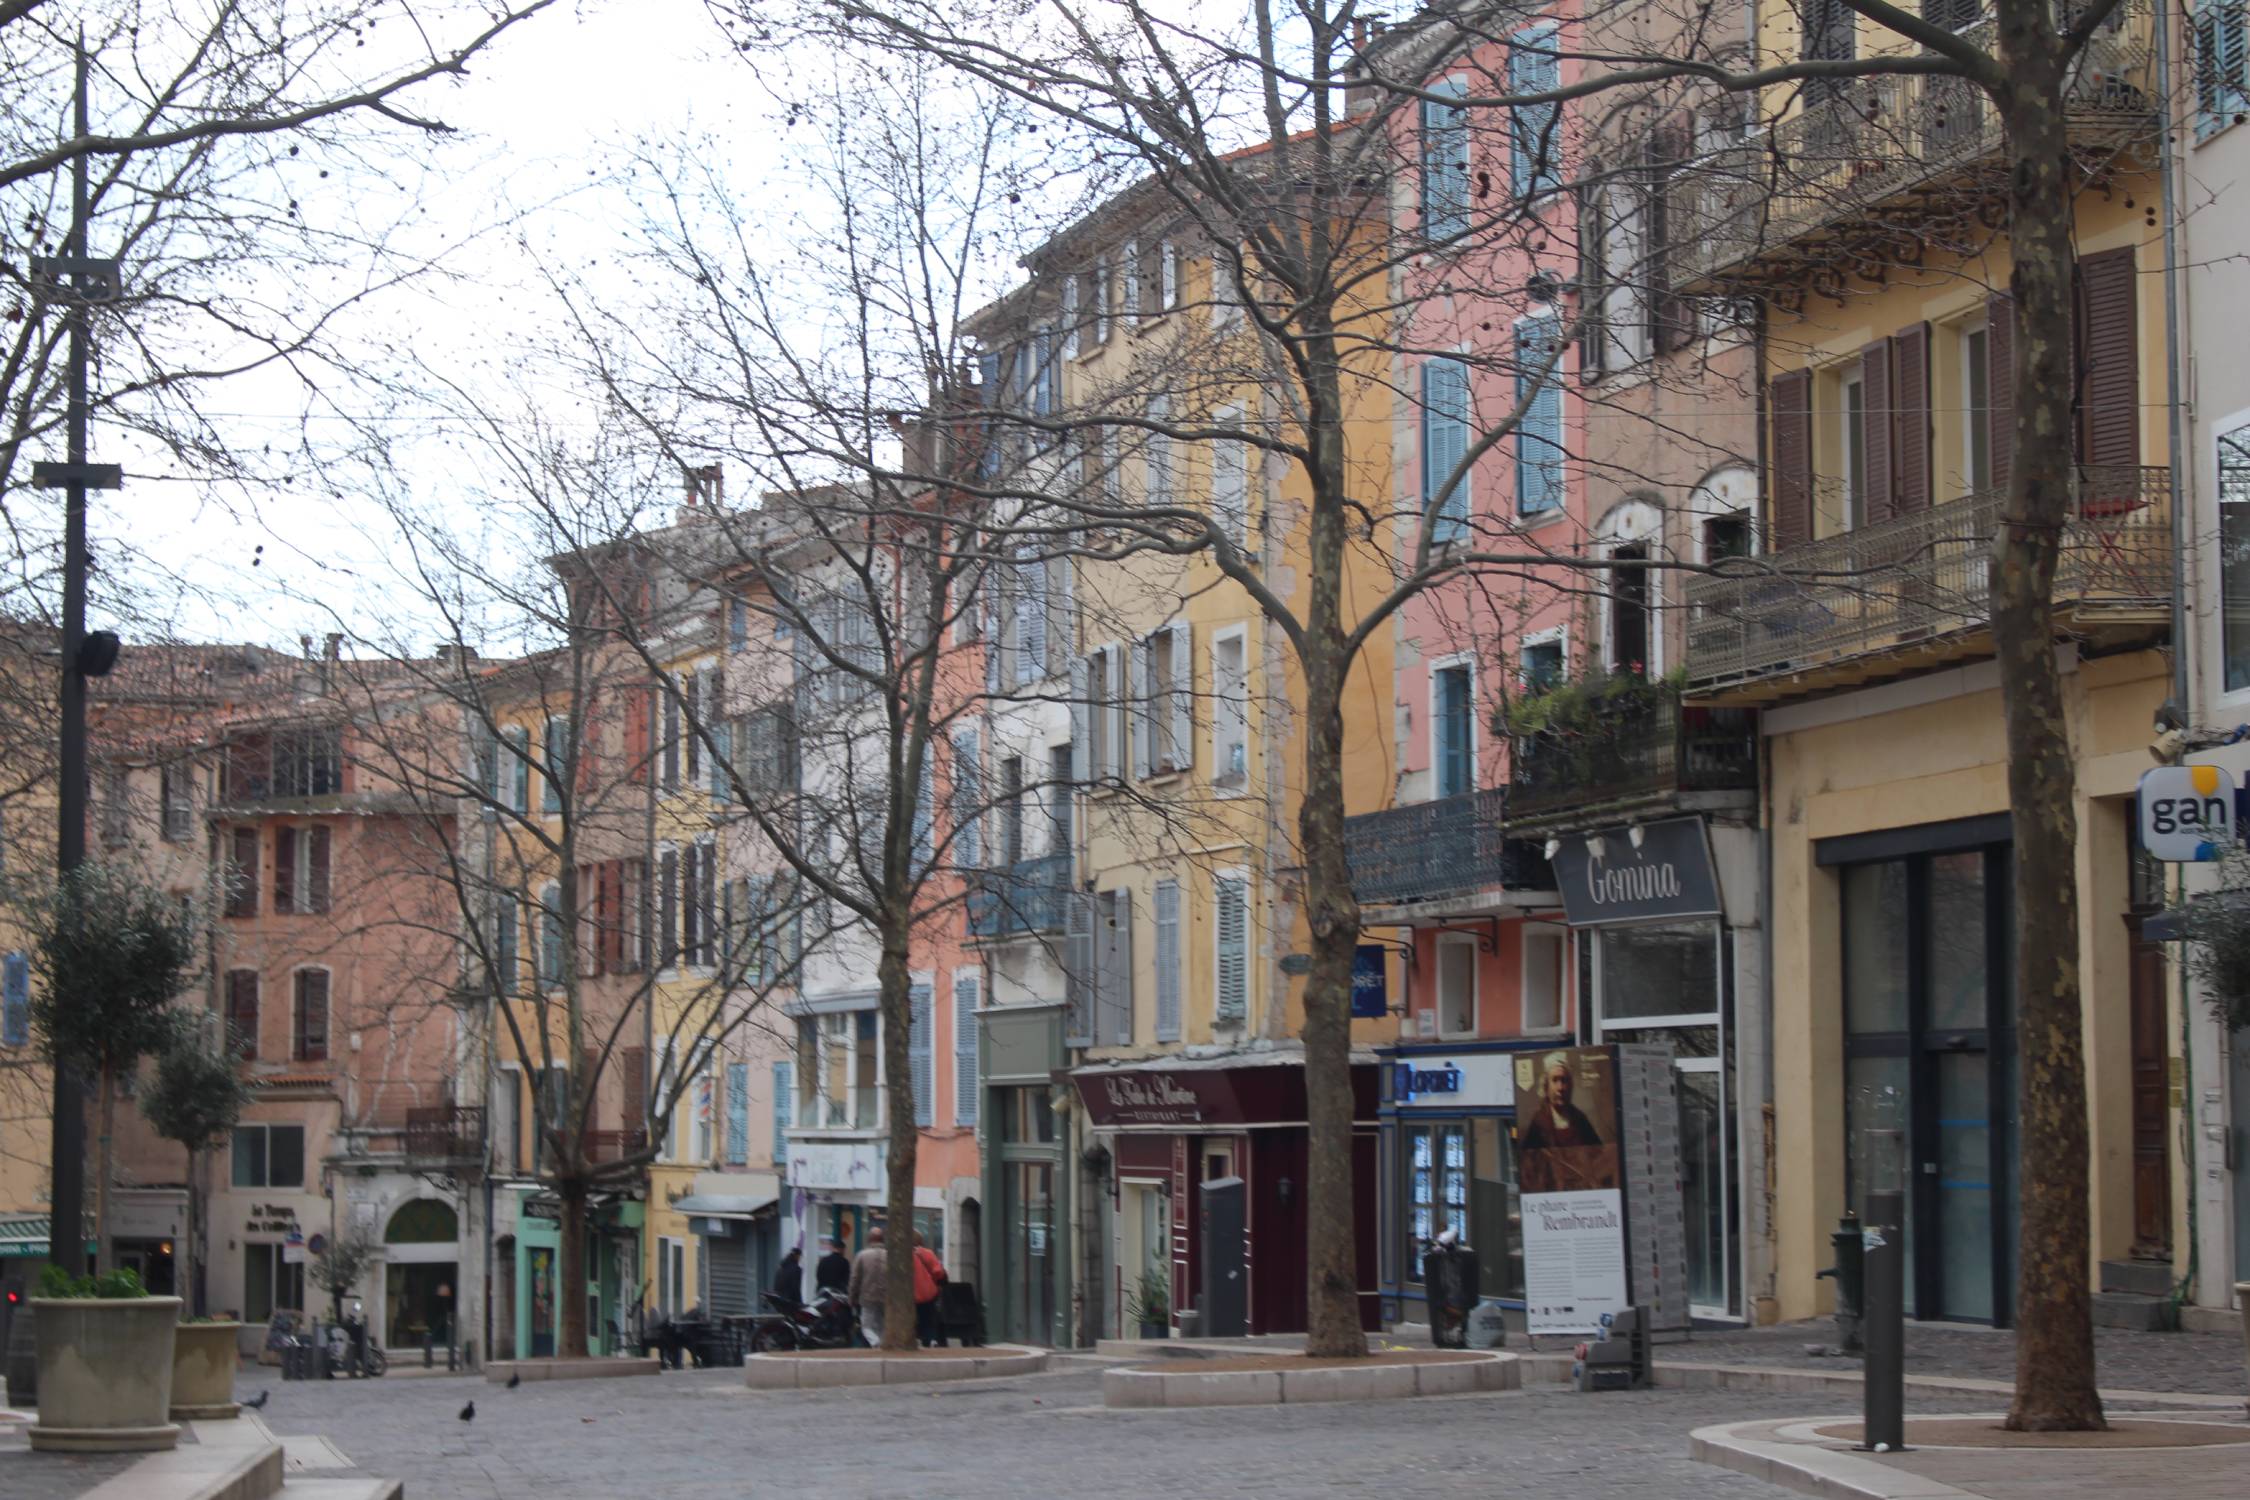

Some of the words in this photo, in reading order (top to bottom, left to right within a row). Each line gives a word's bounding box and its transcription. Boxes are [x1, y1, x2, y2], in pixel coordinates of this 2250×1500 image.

[2152, 797, 2227, 835] gan
[1587, 851, 1681, 904] Gomina
[1352, 972, 1385, 988] ORÊT
[1523, 1201, 1537, 1213] Le
[1543, 1210, 1619, 1231] Rembrandt
